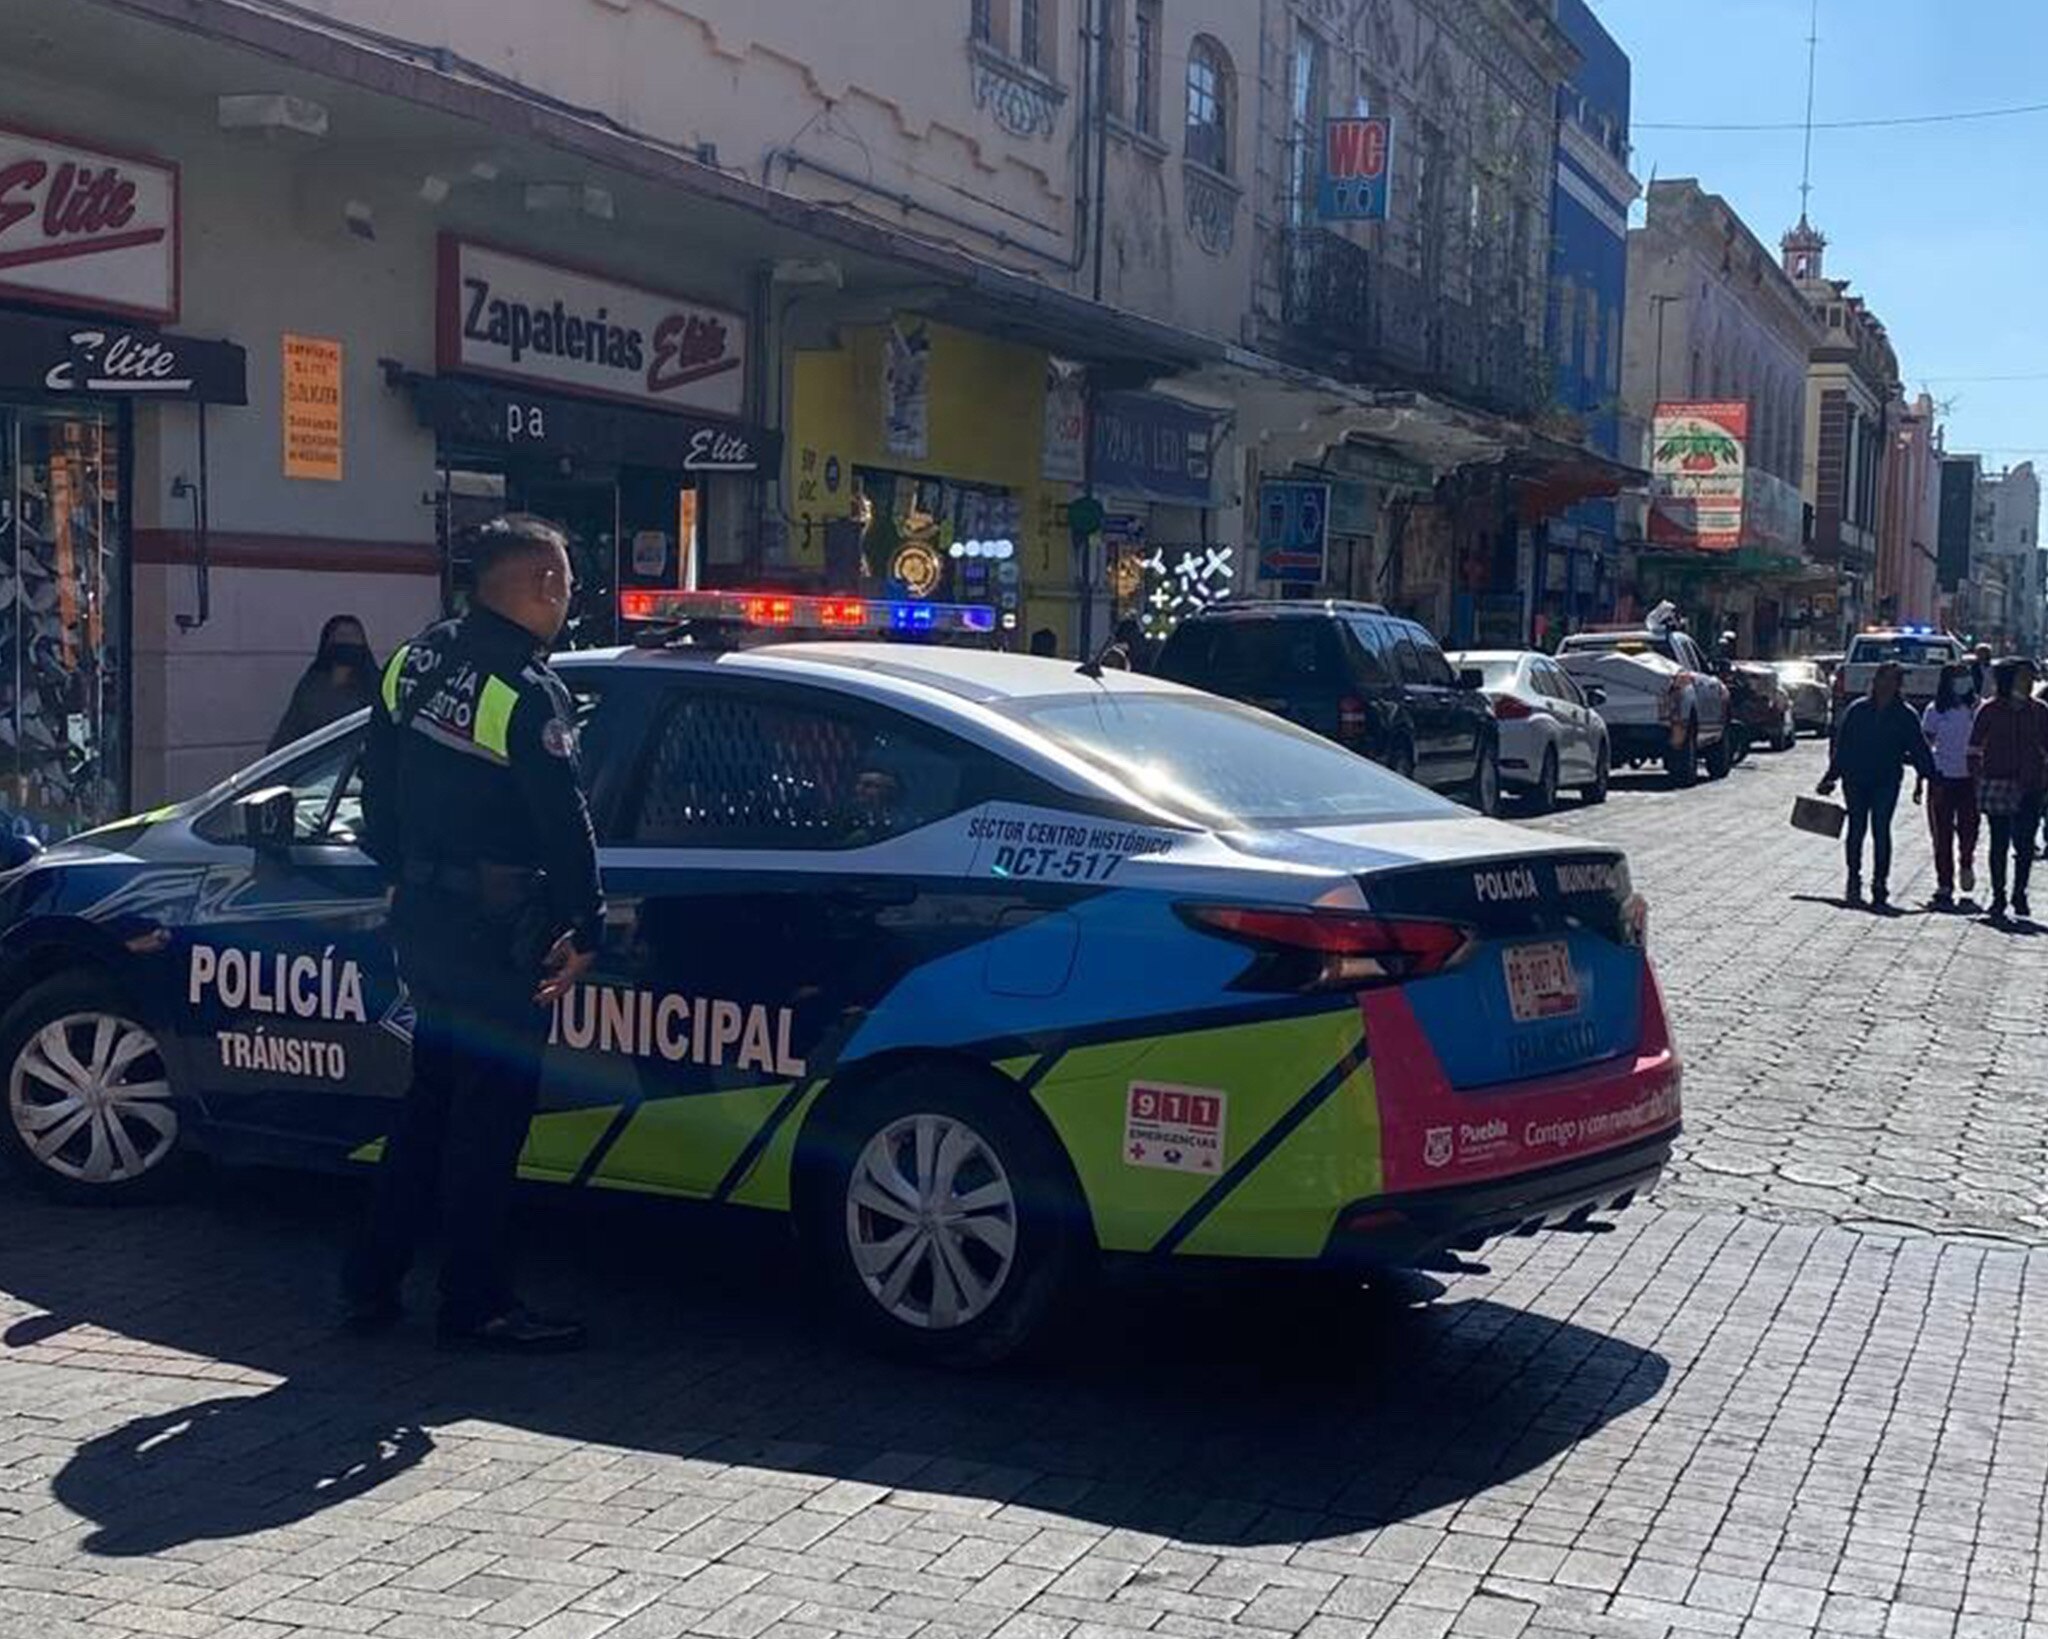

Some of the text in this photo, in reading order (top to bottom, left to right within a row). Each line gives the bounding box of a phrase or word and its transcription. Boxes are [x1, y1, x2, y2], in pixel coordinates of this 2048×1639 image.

[1326, 119, 1386, 180] WC
[0, 159, 137, 238] Elite
[45, 331, 176, 389] Elite
[646, 313, 728, 392] Elite
[684, 429, 748, 469] Elite
[968, 817, 1025, 840] SECTOR
[1026, 822, 1087, 848] CENTRO
[1473, 865, 1539, 901] POLICÍA
[189, 945, 367, 1023] POLICÍA
[217, 1026, 346, 1081] TRÁNSITO
[1137, 1093, 1213, 1123] 911
[1459, 1118, 1509, 1145] Puebla
[1524, 1116, 1576, 1148] Contigo
